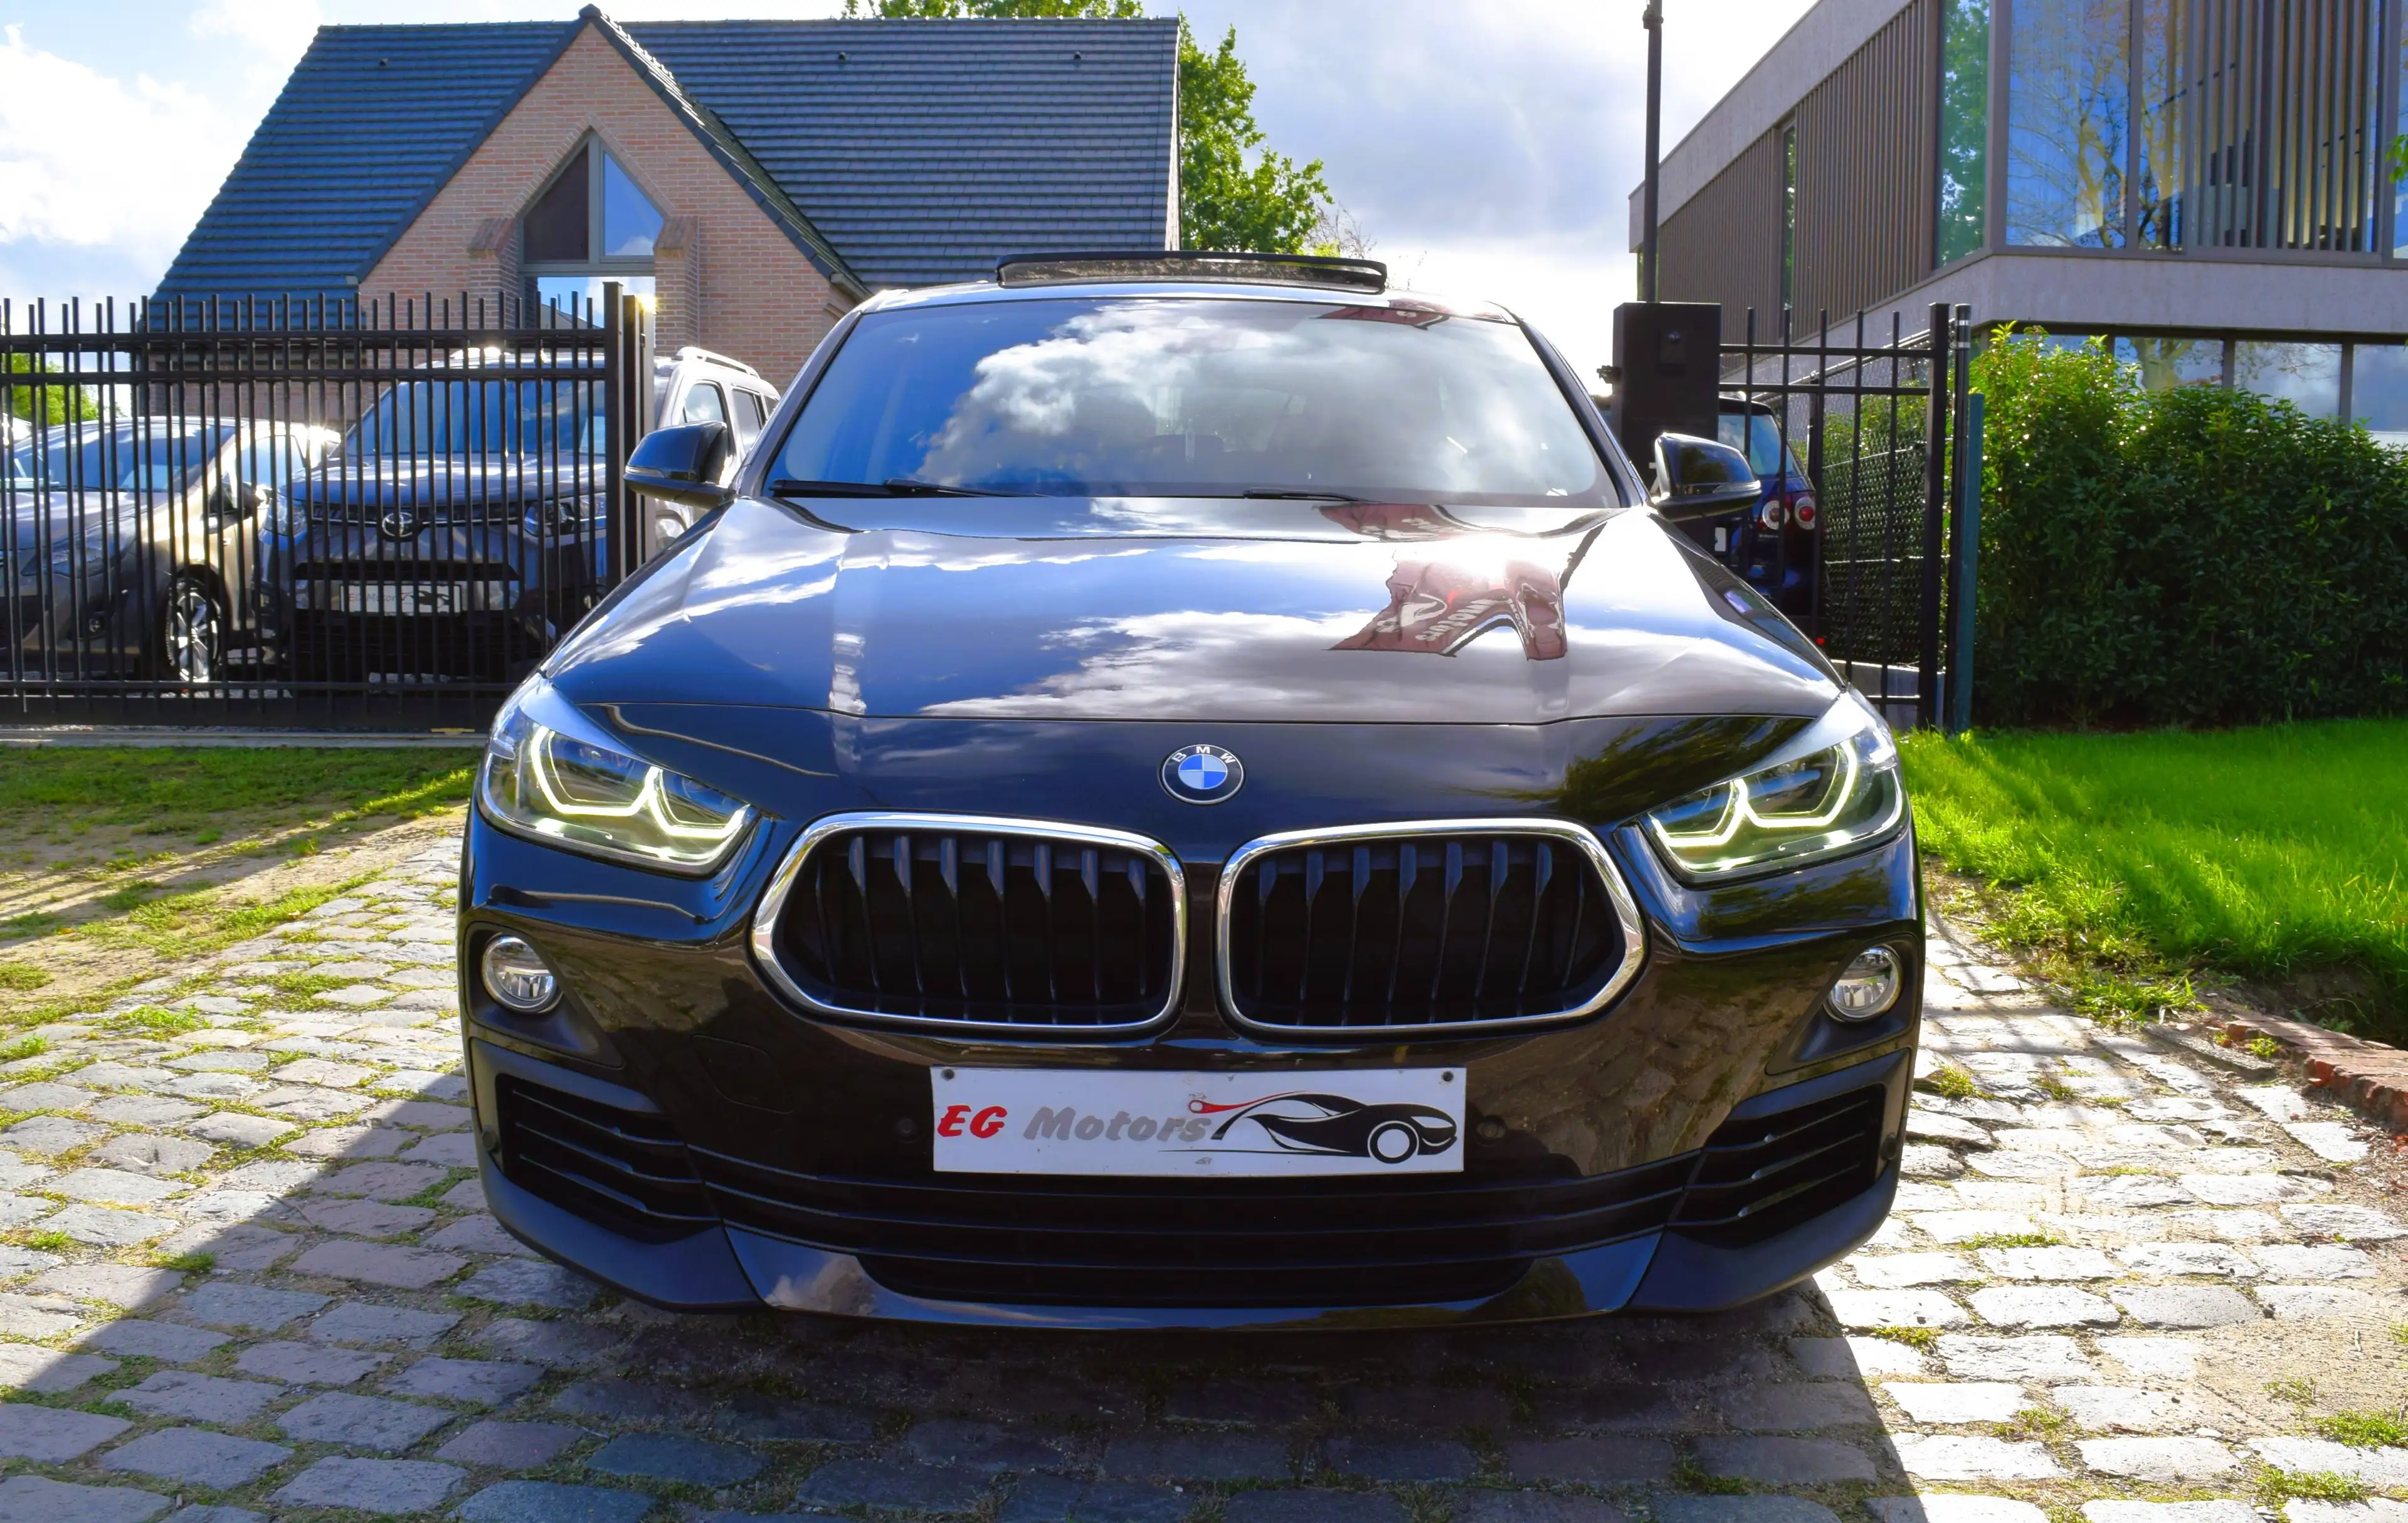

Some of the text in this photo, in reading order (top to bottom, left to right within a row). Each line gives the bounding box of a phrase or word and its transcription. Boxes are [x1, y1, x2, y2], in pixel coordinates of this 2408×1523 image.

[1171, 746, 1236, 764] BMW
[937, 1105, 1212, 1142] EG Motors
